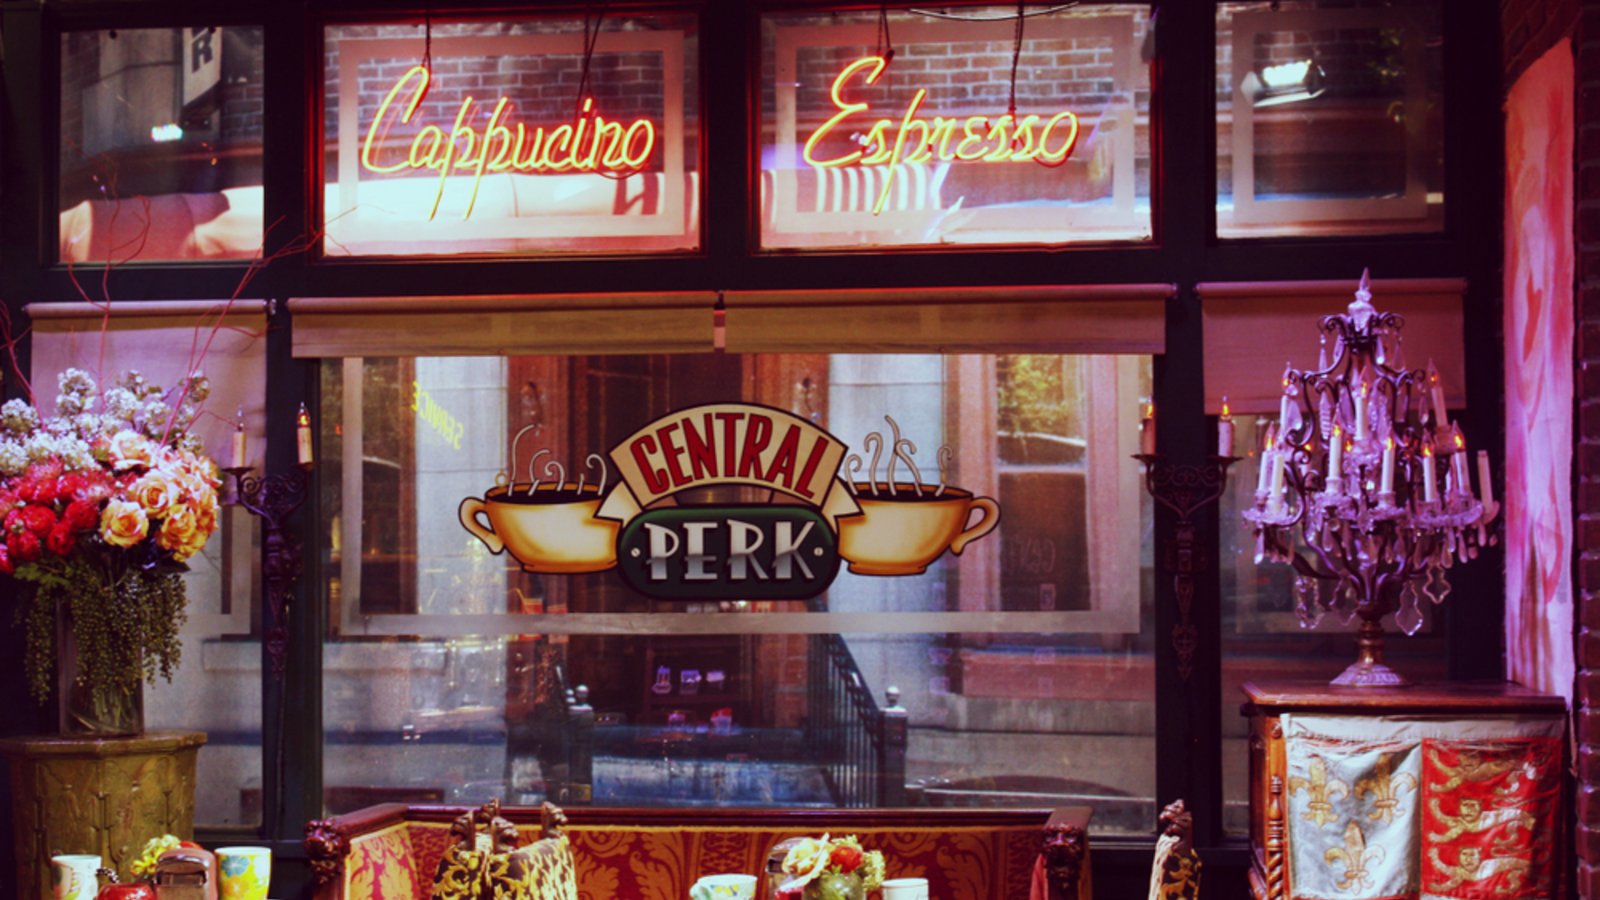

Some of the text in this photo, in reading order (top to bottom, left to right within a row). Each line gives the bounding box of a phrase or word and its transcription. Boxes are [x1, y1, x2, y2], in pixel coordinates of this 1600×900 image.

[361, 65, 655, 220] Cappucino
[803, 56, 1079, 216] Espresso
[629, 412, 829, 500] CENTRAL
[643, 519, 816, 581] PERK
